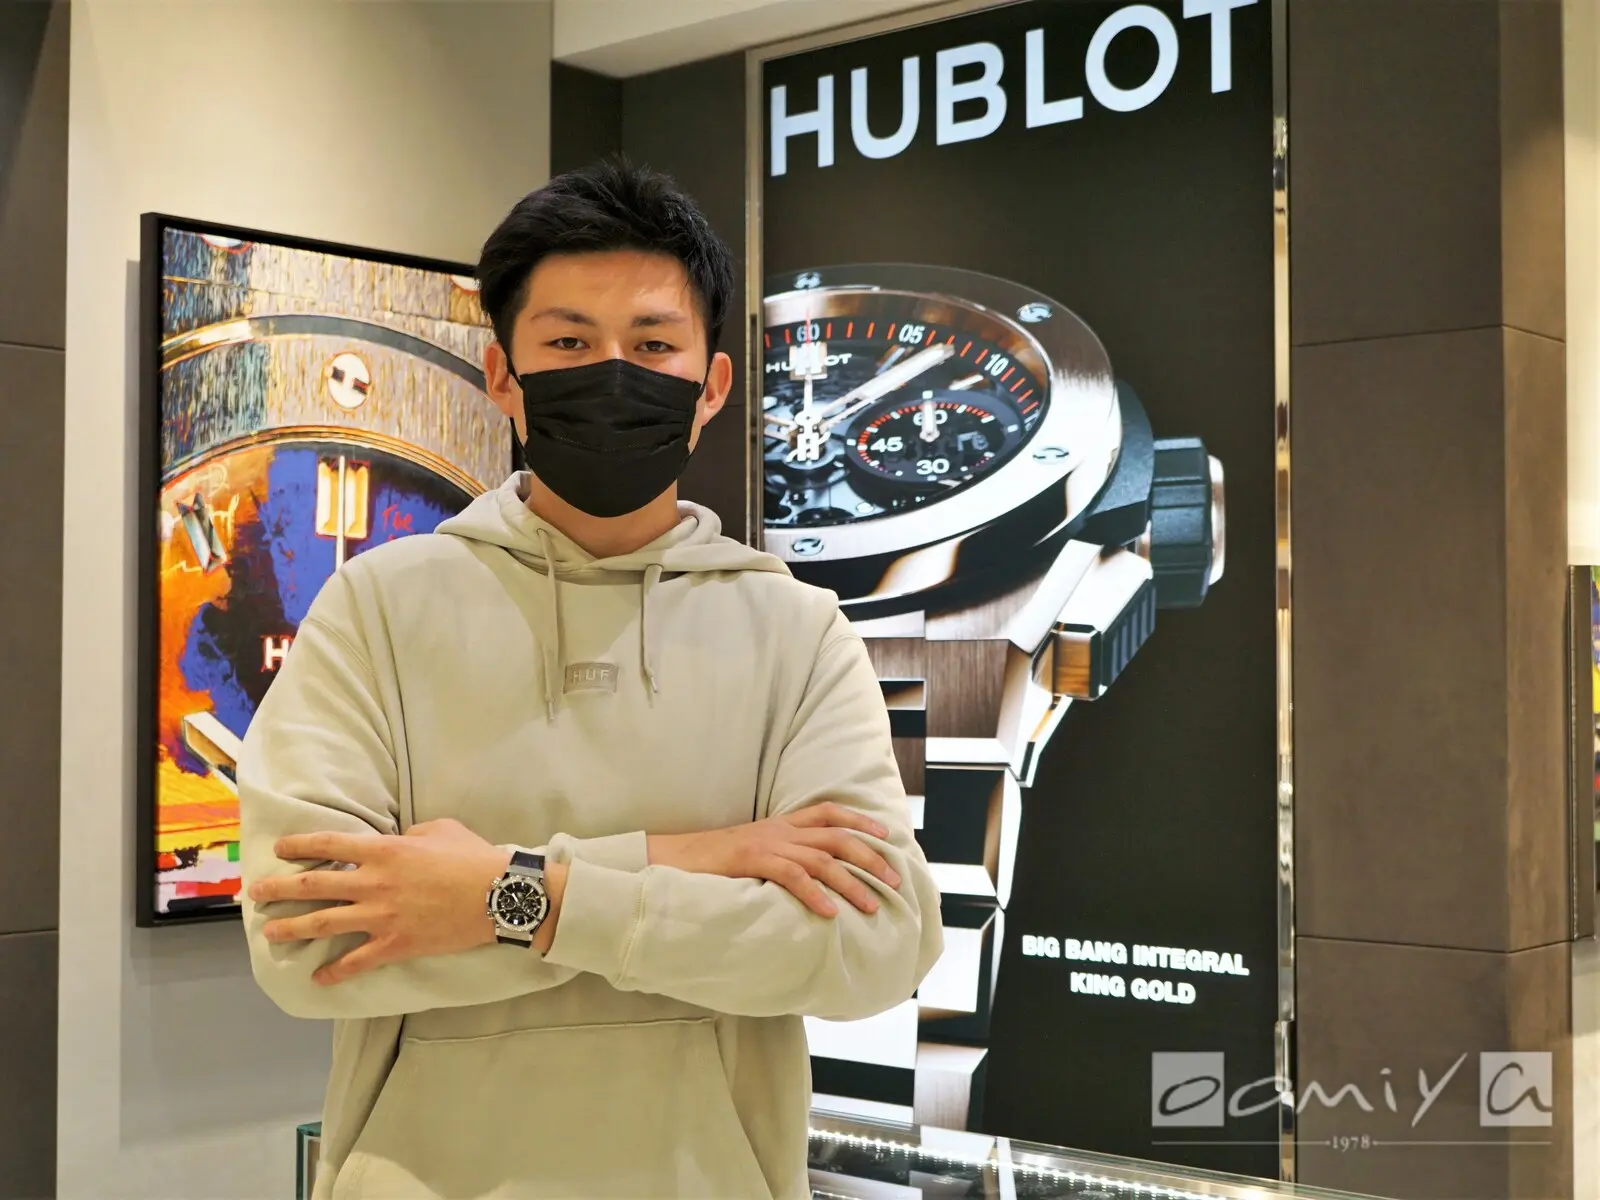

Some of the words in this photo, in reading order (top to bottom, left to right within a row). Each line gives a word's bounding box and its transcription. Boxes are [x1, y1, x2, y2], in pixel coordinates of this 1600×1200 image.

[771, 0, 1258, 177] HUBLOT
[899, 323, 926, 344] 05
[765, 353, 852, 373] HUOT
[984, 353, 1009, 376] 10
[870, 436, 903, 452] 45
[916, 458, 950, 475] 30
[571, 668, 611, 684] HUF
[1022, 935, 1060, 958] BIG
[1065, 938, 1128, 964] BANG
[1133, 944, 1250, 976] INTEGRAL
[1070, 972, 1126, 997] KING
[1130, 978, 1196, 1005] GOLD
